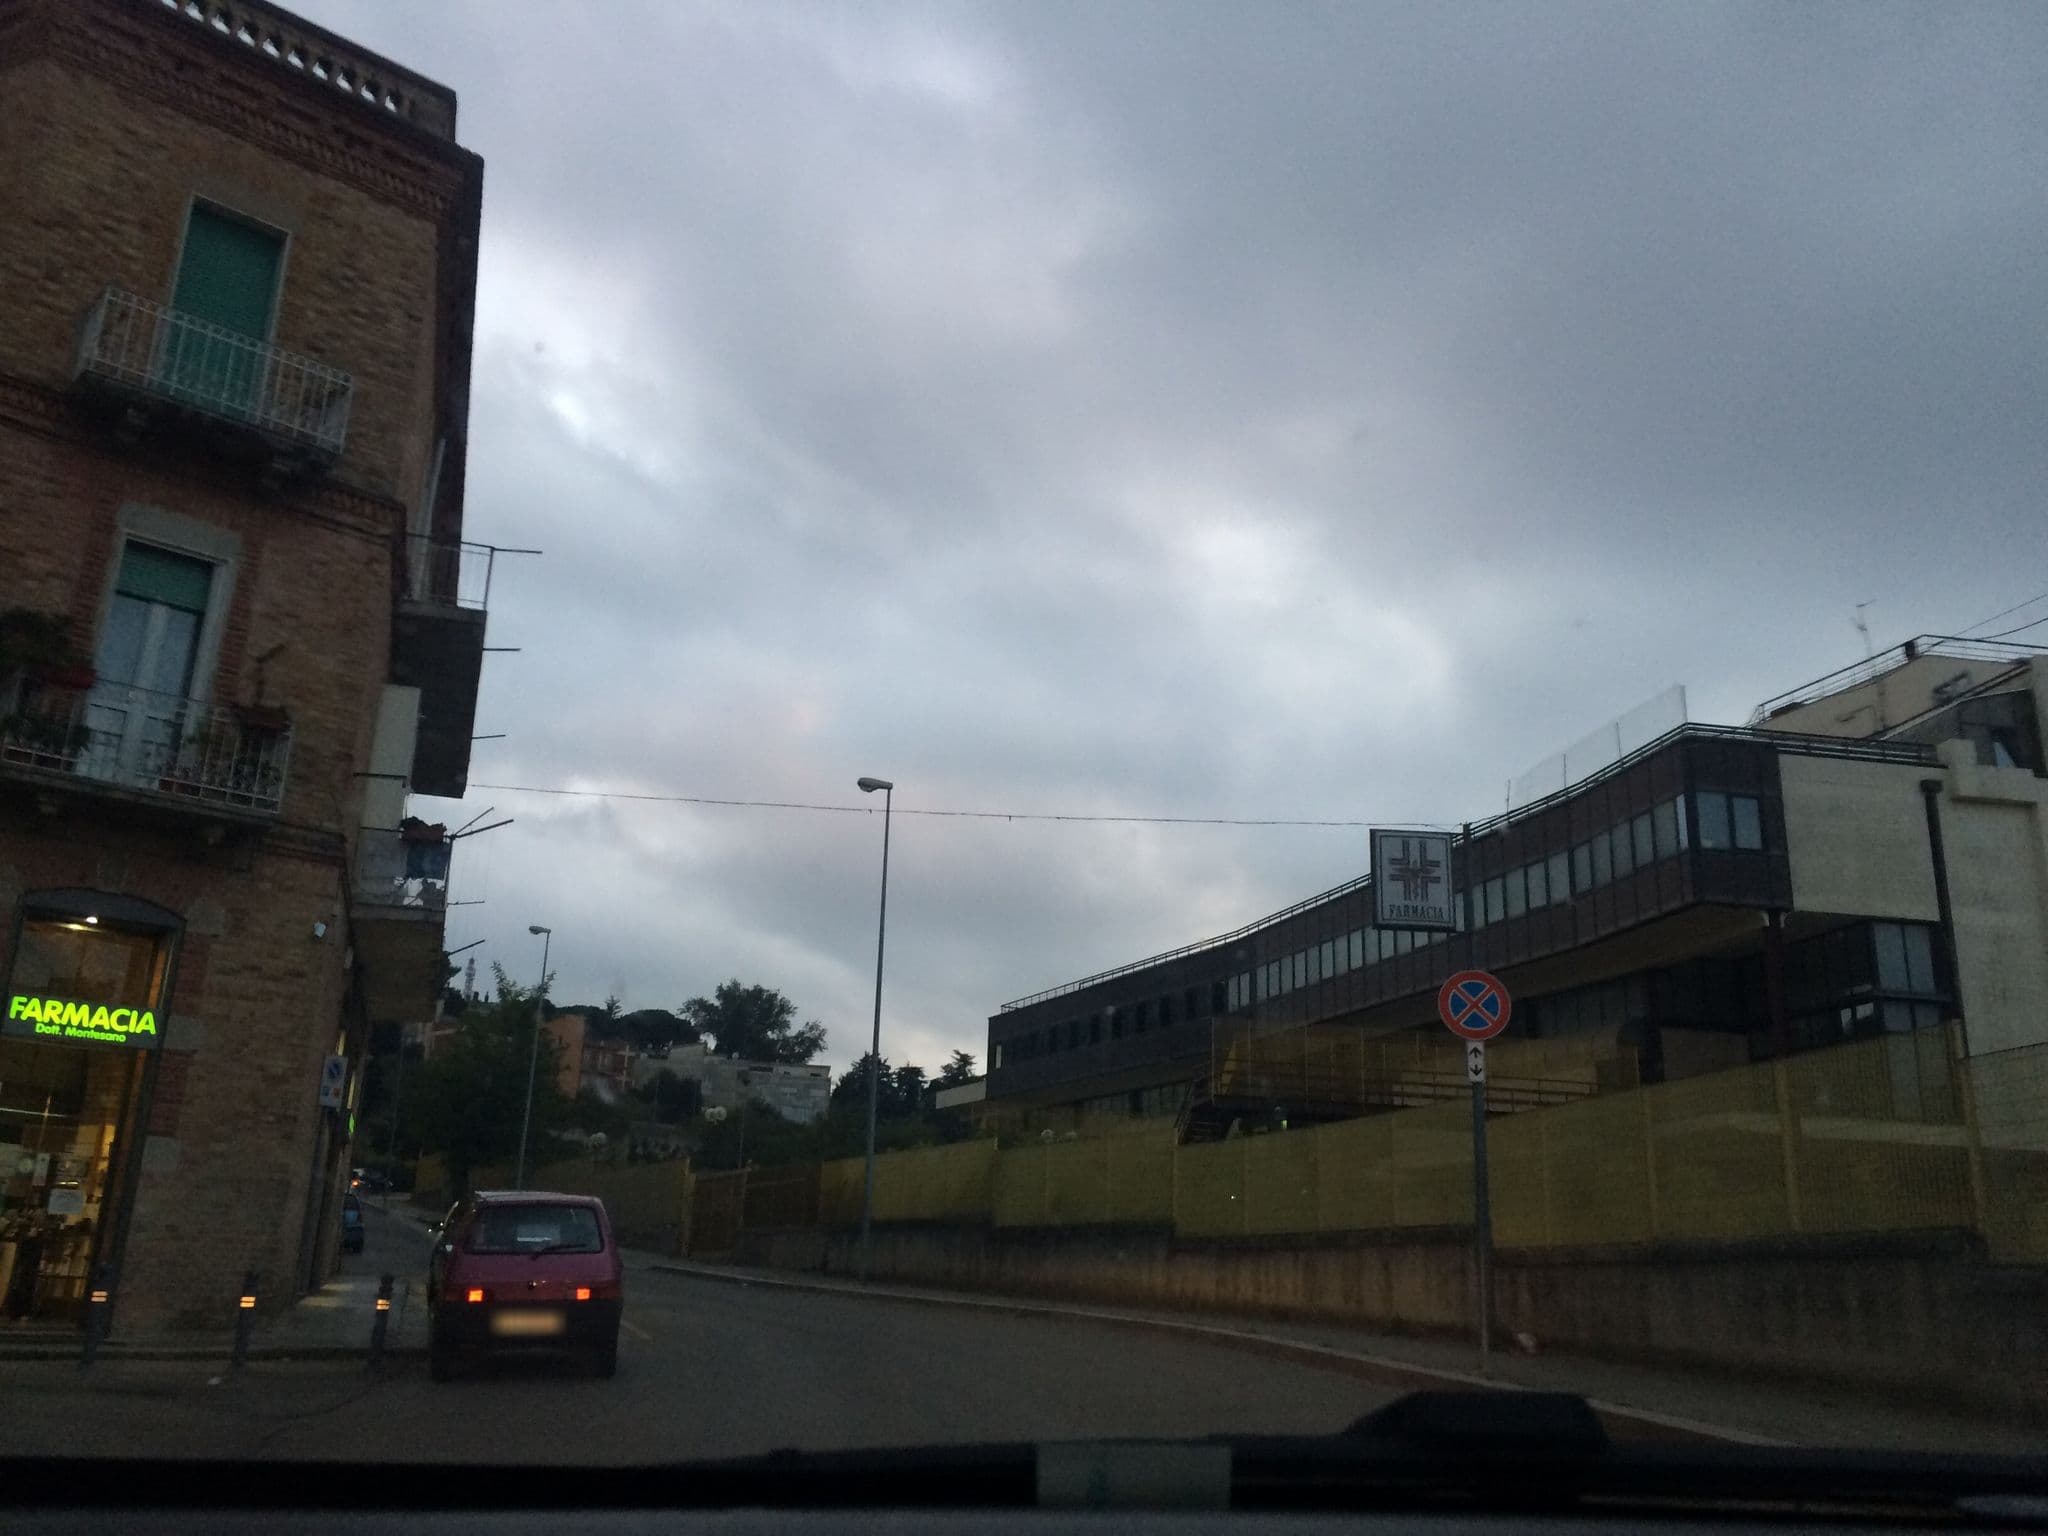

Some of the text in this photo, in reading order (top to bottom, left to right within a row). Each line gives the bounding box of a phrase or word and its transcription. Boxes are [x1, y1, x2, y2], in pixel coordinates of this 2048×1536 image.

[1389, 904, 1445, 921] FARMACIA
[9, 996, 156, 1035] FARMACIA
[35, 1022, 126, 1042] Dott. Montesano
